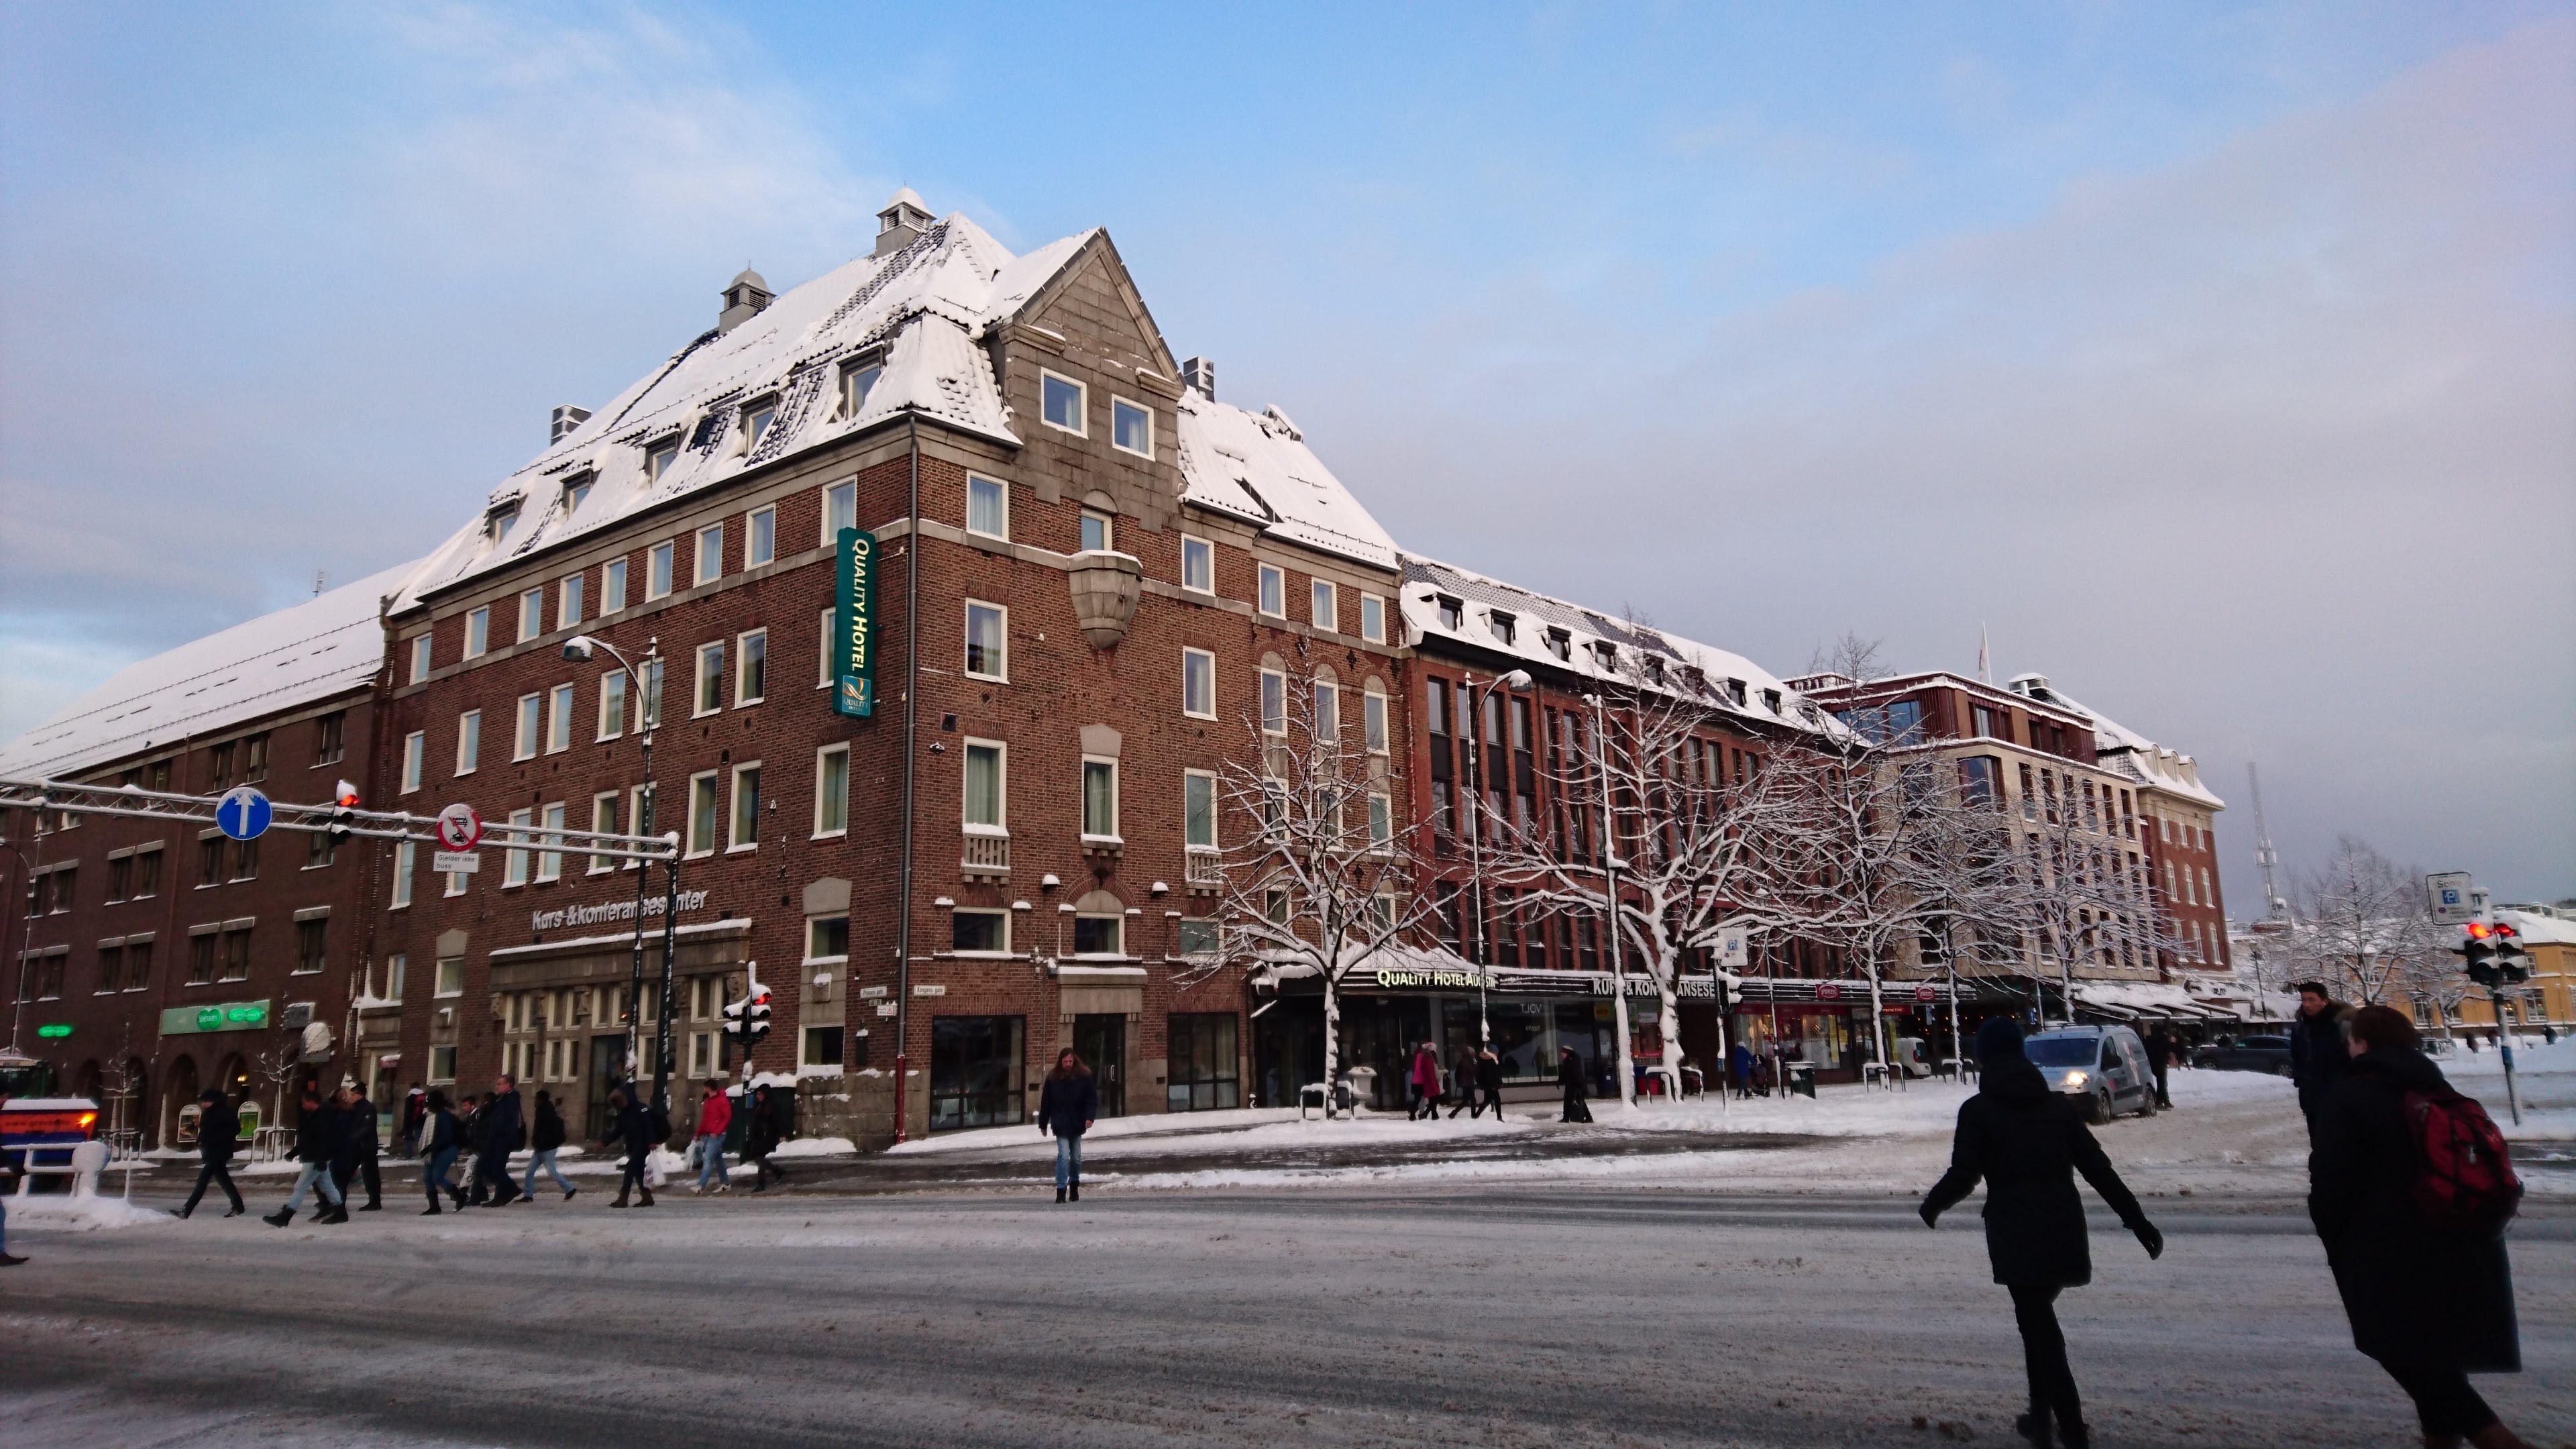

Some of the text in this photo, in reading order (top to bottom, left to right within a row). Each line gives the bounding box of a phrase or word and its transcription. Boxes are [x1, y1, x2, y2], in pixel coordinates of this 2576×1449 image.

[578, 889, 708, 925] konferansesnter
[1377, 969, 1496, 988] QUALITY HOTEL AUSTIN
[1593, 978, 1626, 996] KUR
[1626, 980, 1633, 996] &
